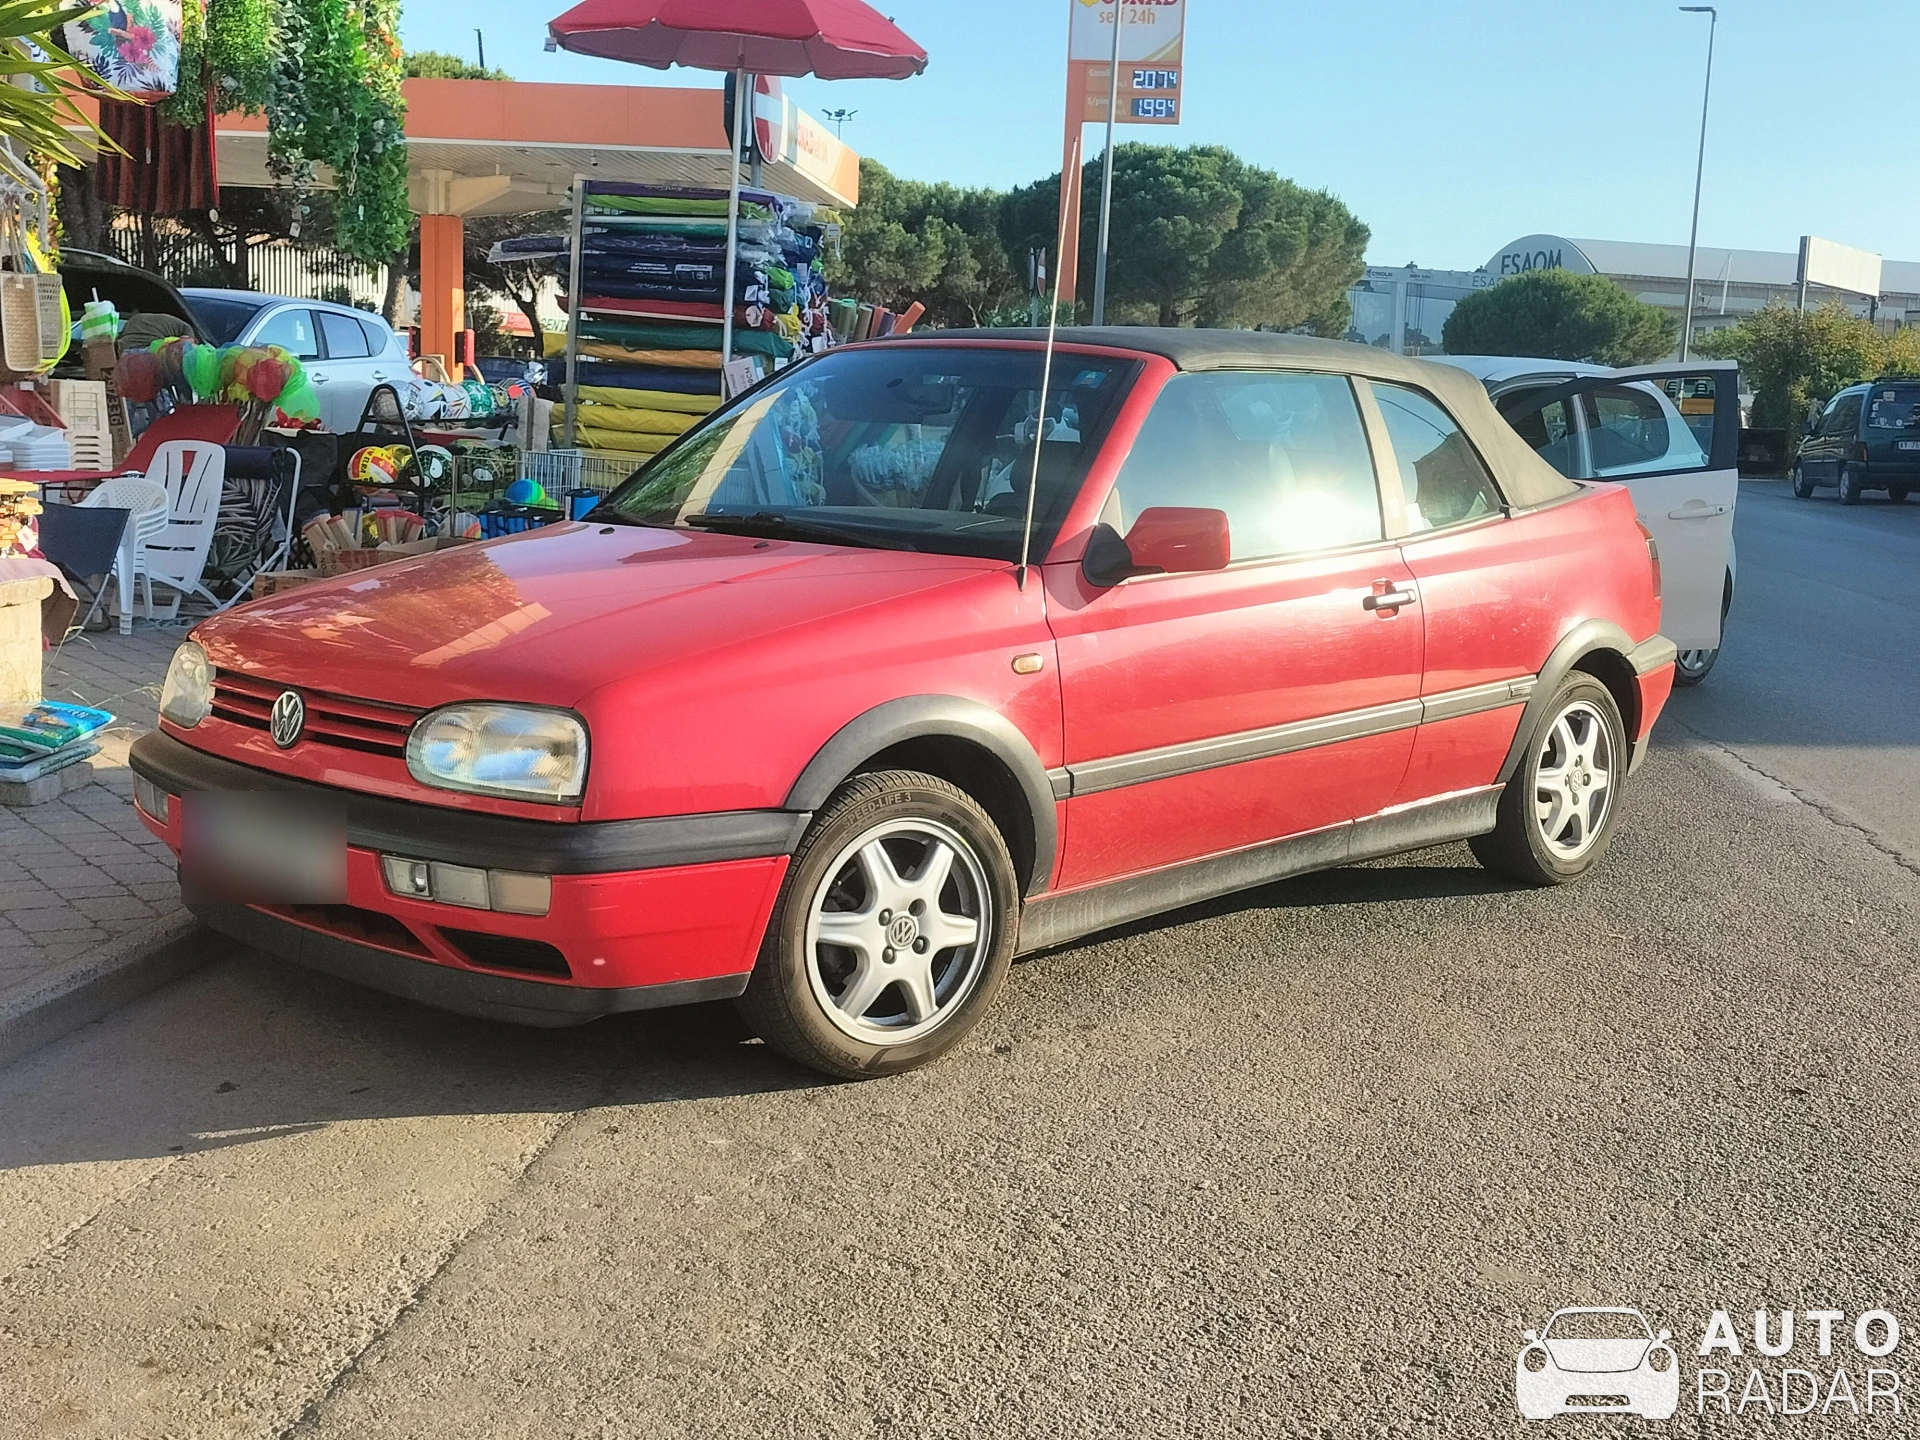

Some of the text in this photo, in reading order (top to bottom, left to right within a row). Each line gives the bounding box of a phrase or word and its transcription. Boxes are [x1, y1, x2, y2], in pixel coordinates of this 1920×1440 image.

[1098, 6, 1156, 25] sef 24h
[1501, 248, 1562, 274] ESAOM
[841, 792, 912, 830] SPEED-LIFE 3
